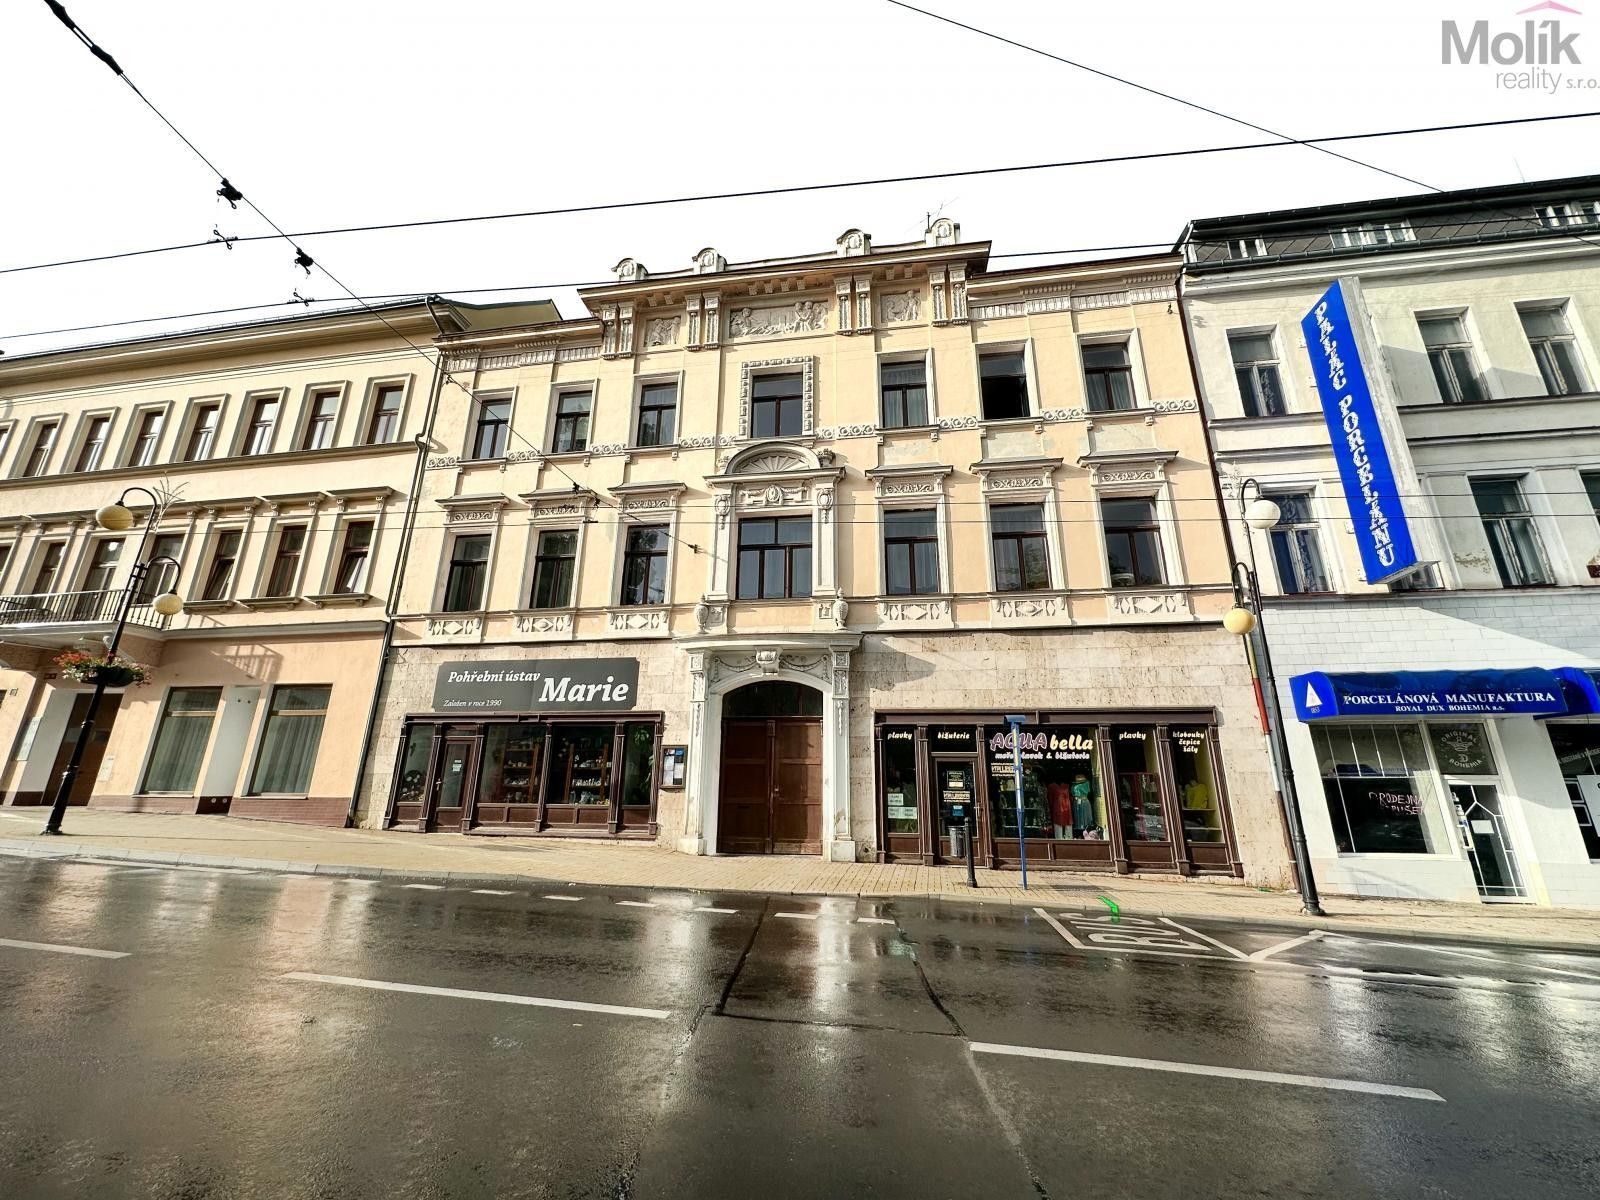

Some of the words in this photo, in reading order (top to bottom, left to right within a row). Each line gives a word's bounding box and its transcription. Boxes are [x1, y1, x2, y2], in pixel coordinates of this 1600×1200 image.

[448, 670, 504, 683] Pohřební
[505, 670, 540, 682] ústav
[538, 676, 629, 702] Marie
[1343, 692, 1439, 705] PORCELÁNOVÁ
[1445, 691, 1556, 704] MANUFAKTURA
[486, 699, 502, 707] 1990
[887, 731, 913, 740] plavky
[937, 731, 970, 740] bižuterie
[1119, 731, 1146, 740] plavky
[1172, 731, 1205, 739] klobouky
[1050, 734, 1094, 750] bella
[1021, 751, 1044, 760] lavek
[1058, 911, 1213, 951] BUS
